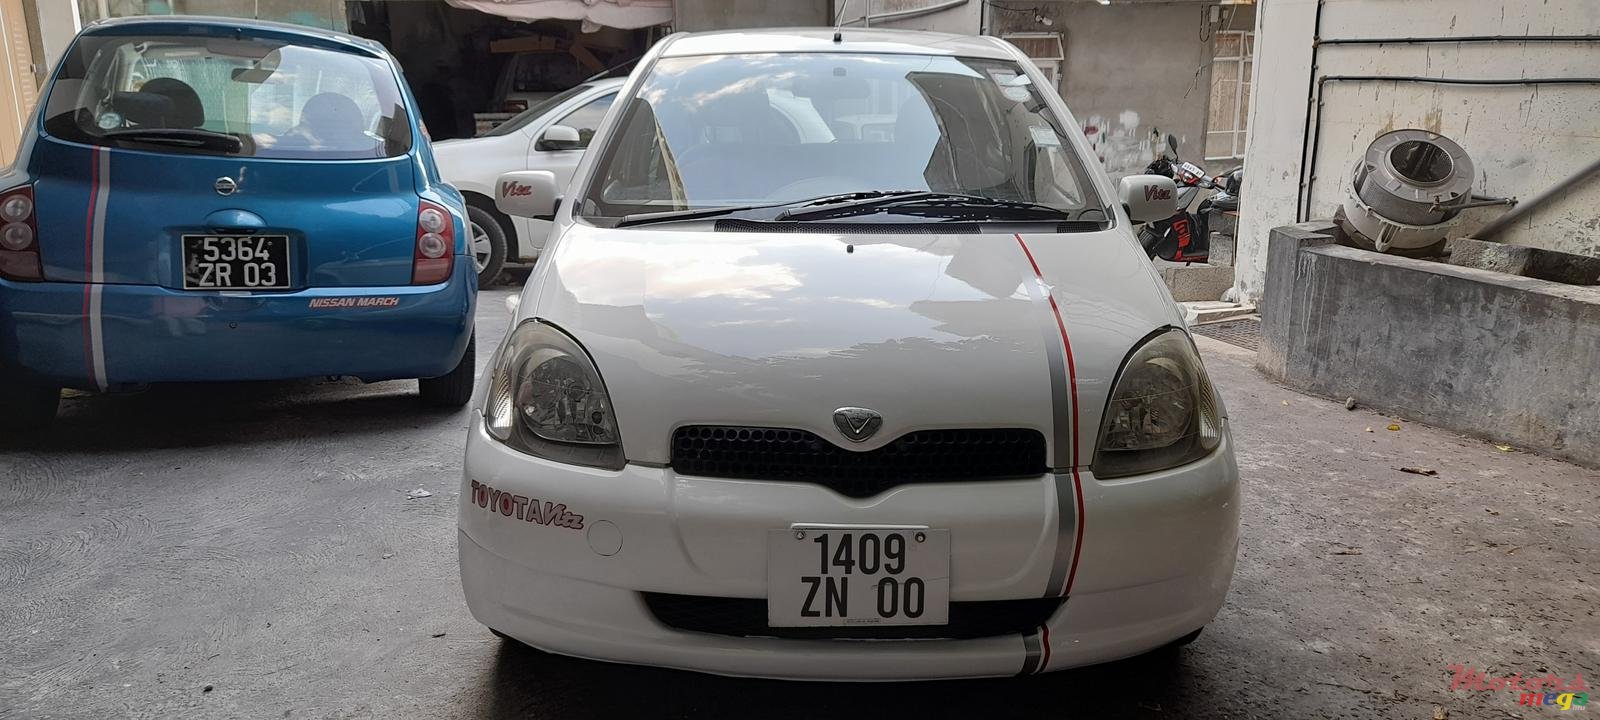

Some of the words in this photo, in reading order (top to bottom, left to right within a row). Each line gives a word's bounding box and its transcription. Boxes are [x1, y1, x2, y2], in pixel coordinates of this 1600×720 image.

[203, 237, 270, 261] 5364
[198, 262, 232, 286] ZR
[243, 262, 277, 286] 03
[308, 297, 356, 308] NISSAN
[356, 297, 400, 306] MARCH
[471, 479, 543, 525] TOYOTA
[543, 501, 584, 530] Vitz
[813, 533, 906, 575] 1409
[800, 576, 848, 618] ZN
[877, 576, 925, 619] 00
